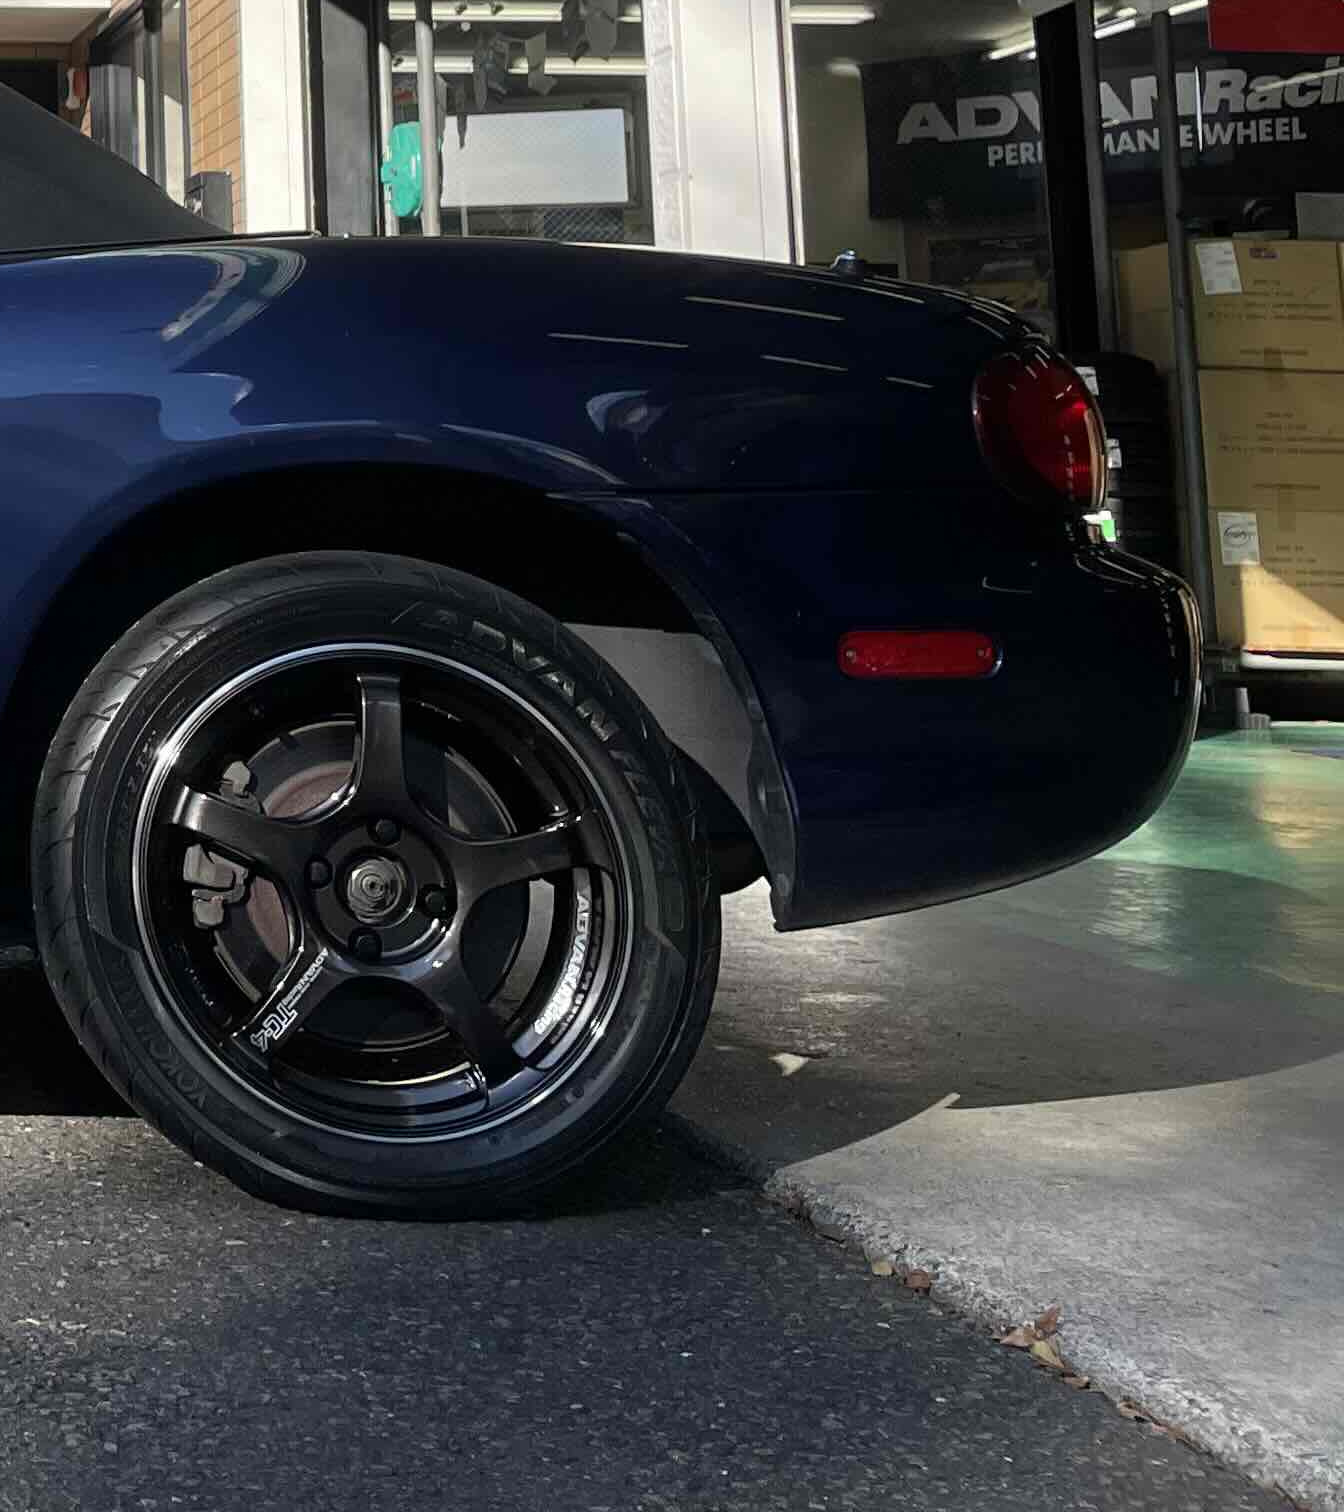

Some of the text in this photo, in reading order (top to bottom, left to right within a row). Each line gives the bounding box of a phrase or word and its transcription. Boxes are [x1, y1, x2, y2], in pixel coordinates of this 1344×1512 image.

[896, 72, 1201, 145] ADN
[988, 116, 1308, 168] PERMANE WHEEL
